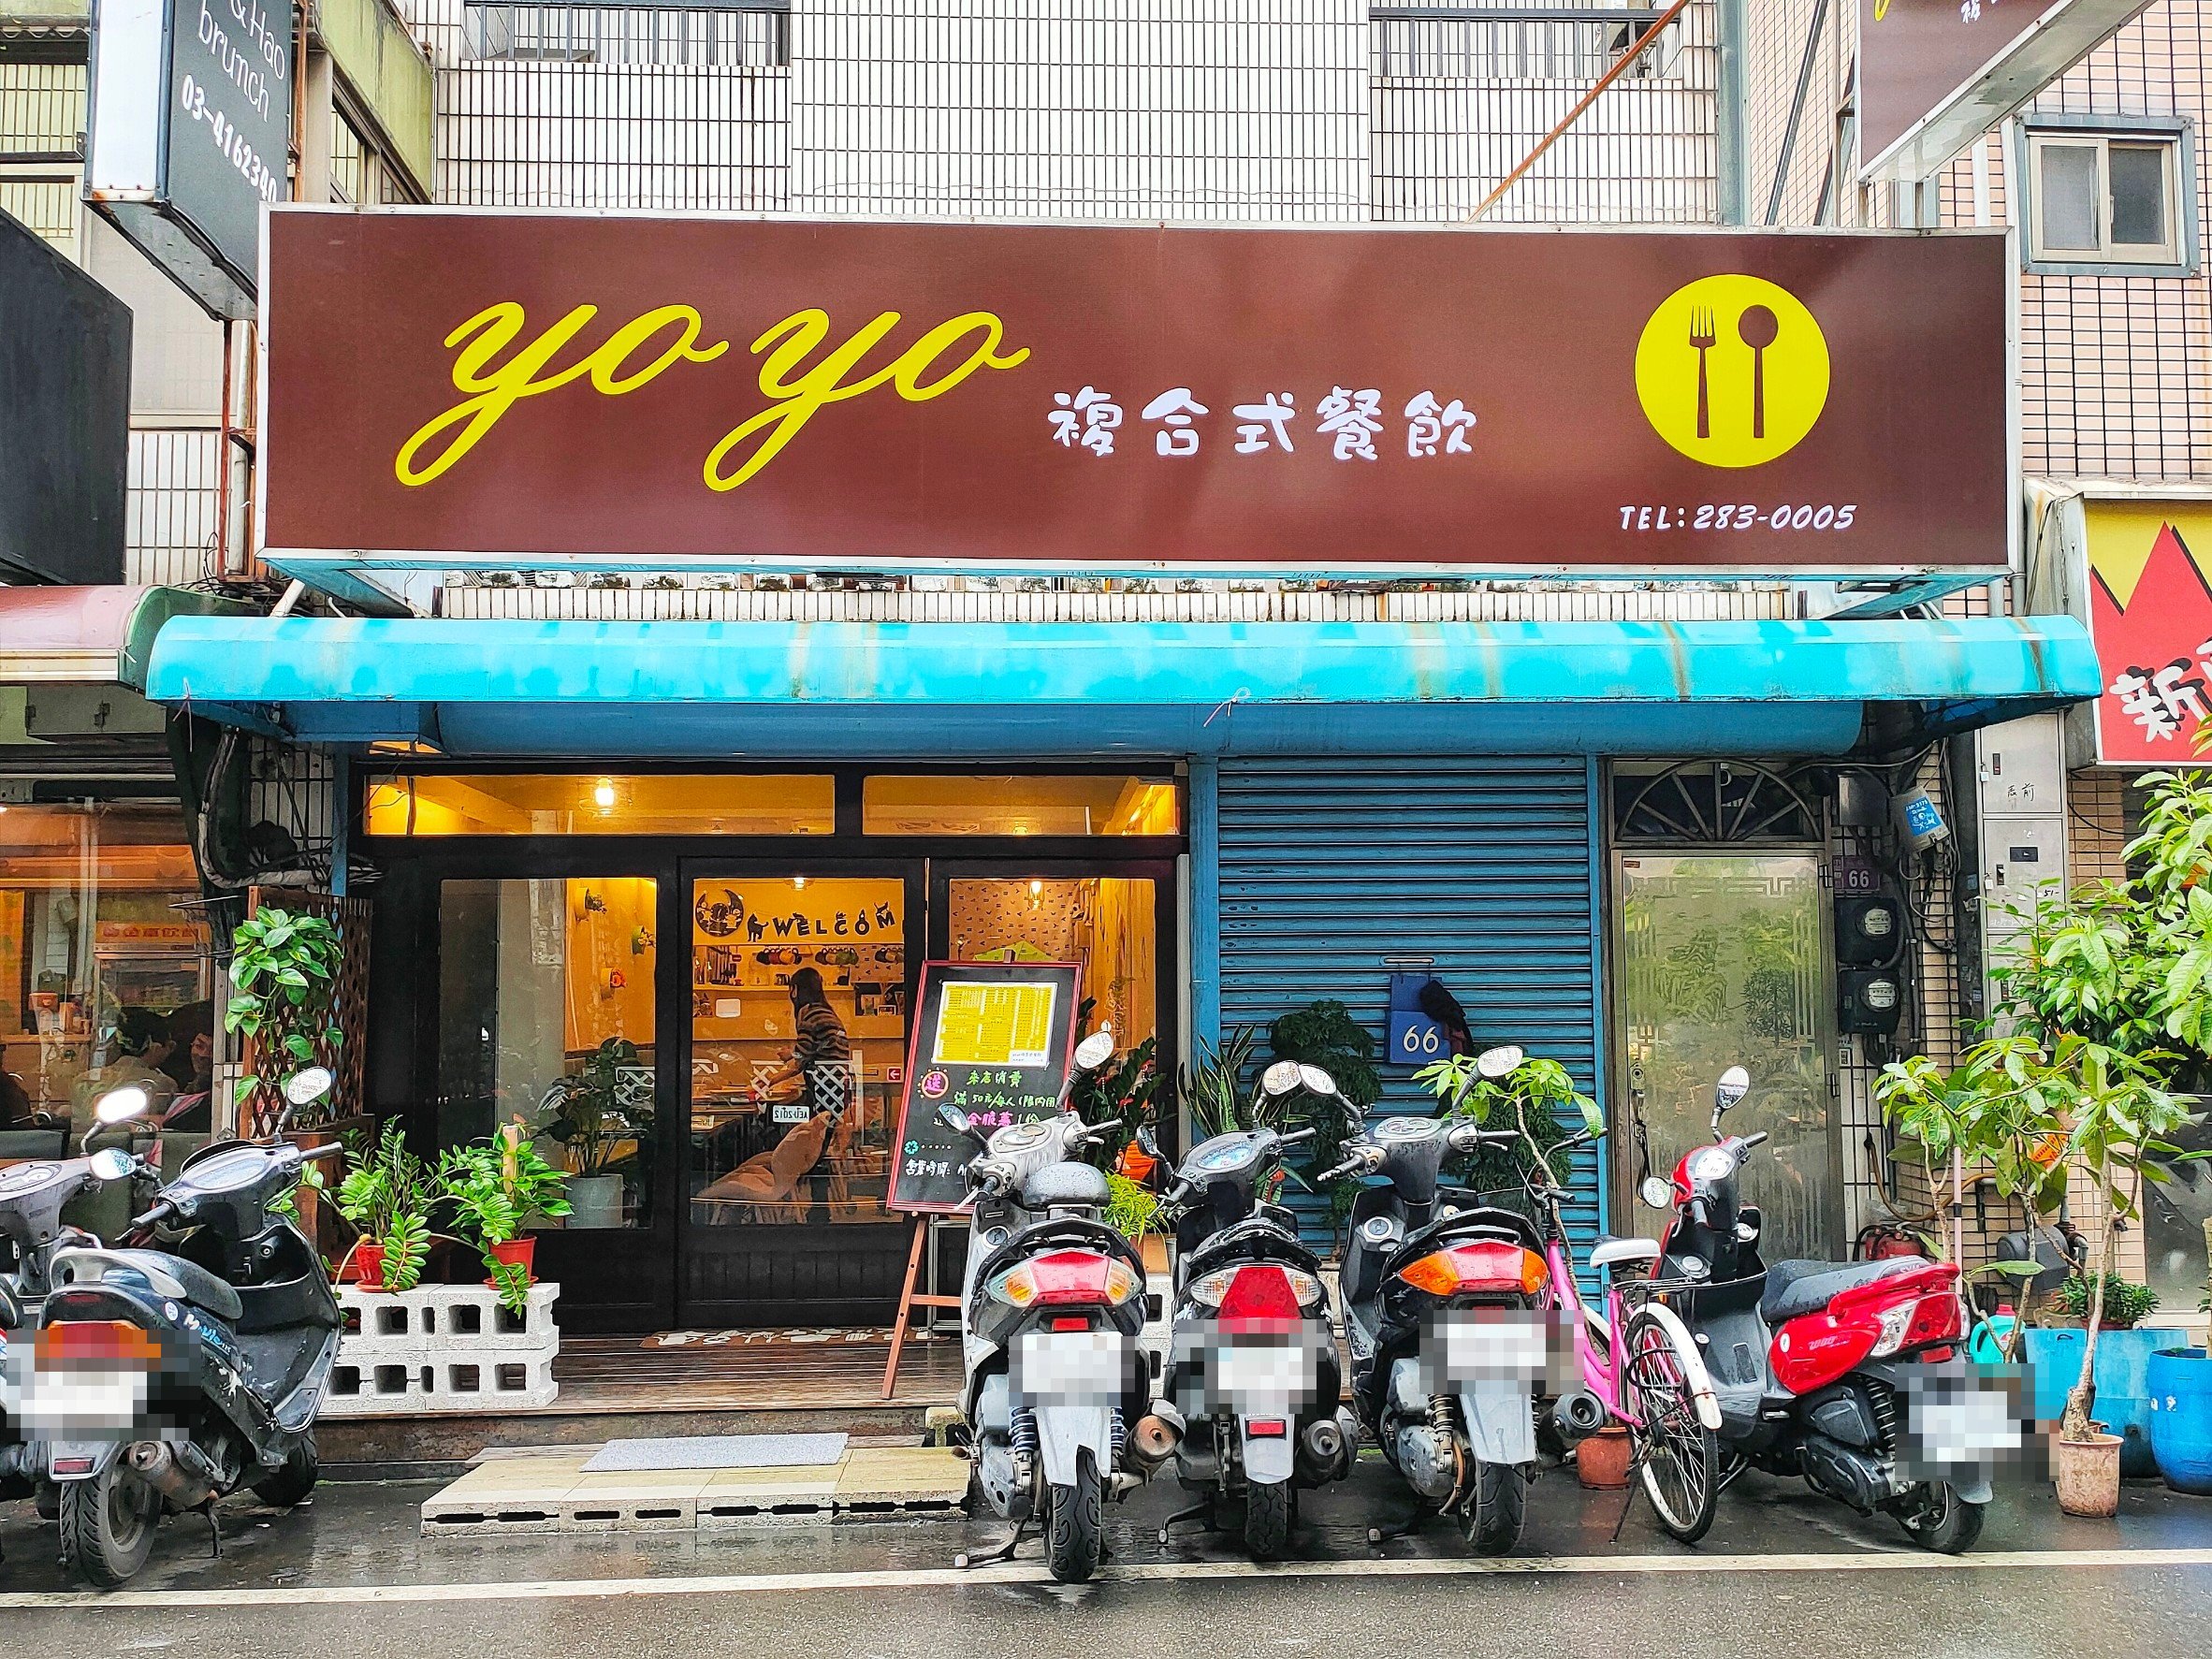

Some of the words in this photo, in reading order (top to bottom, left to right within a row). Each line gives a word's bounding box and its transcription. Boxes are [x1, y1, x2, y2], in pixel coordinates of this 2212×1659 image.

[198, 0, 269, 123] brunch
[1047, 385, 1477, 460] 複合式餐飲
[2110, 638, 2212, 743] 新
[1848, 869, 1870, 888] 66
[773, 908, 904, 937] WELCOM
[1403, 1025, 1439, 1054] 66
